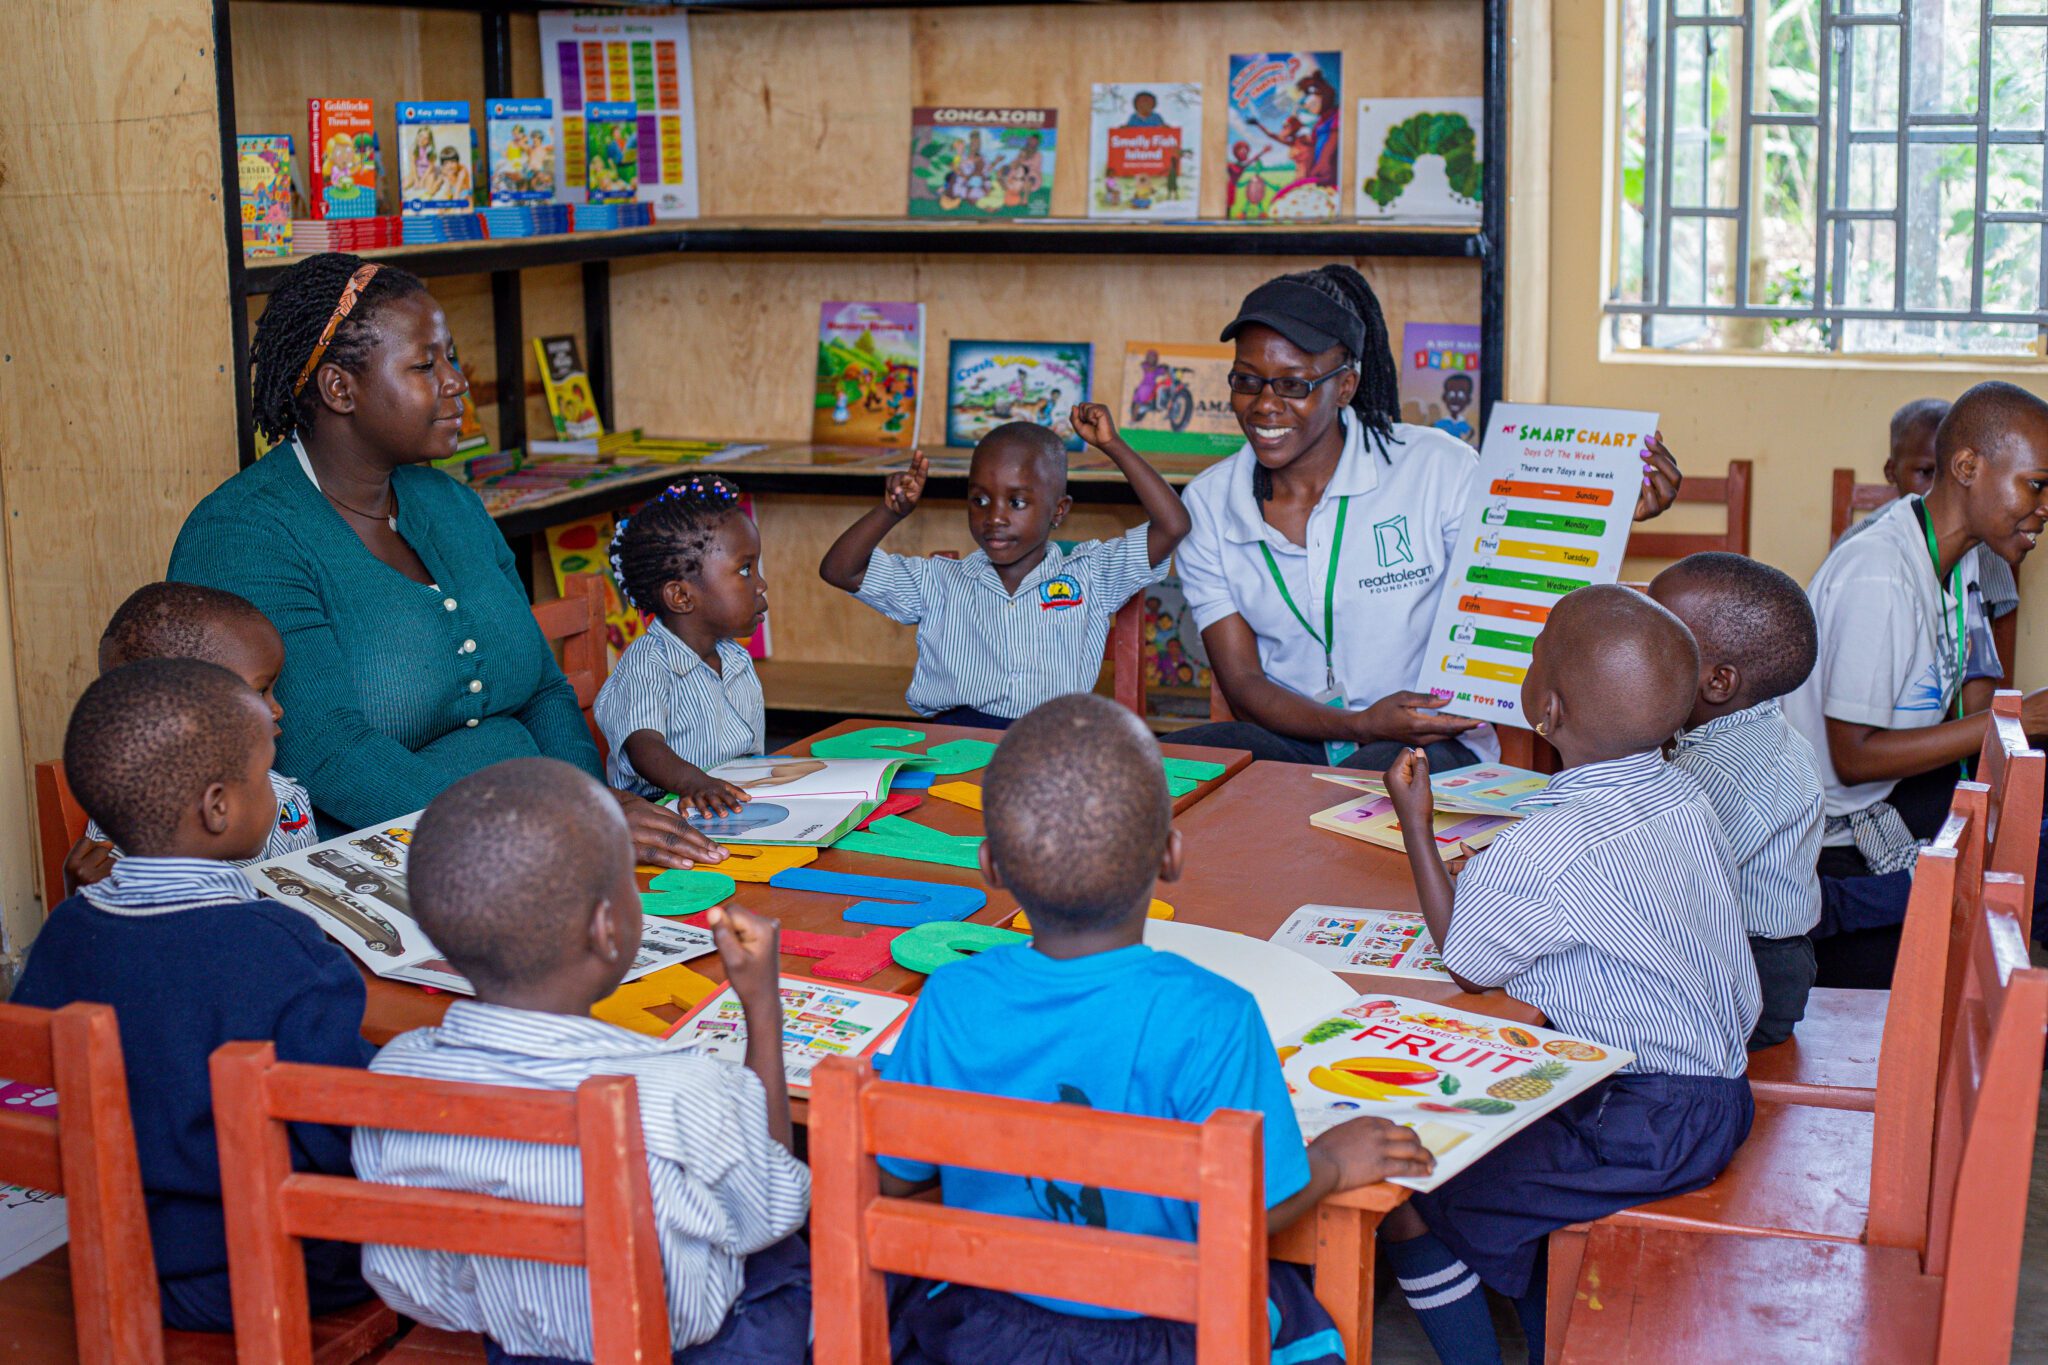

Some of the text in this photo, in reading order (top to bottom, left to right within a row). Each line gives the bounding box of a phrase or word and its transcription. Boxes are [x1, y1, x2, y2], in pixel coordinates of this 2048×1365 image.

[417, 108, 432, 117] Key
[1111, 135, 1178, 150] Smelly Fish
[1124, 148, 1163, 160] Island
[1502, 424, 1637, 447] MY SMART CHART
[1523, 447, 1595, 461] Days Of The Week
[1520, 464, 1539, 473] There
[1595, 472, 1614, 480] week
[1496, 484, 1599, 502] First Sunday
[1488, 512, 1590, 531] Second Monday
[1481, 540, 1591, 564] Third Tuesday
[1358, 564, 1434, 588] readtolearn
[1370, 578, 1429, 594] FOUNDATION
[1546, 580, 1583, 592] Wednesd
[1464, 602, 1481, 611] Fifth
[1457, 633, 1471, 641] Sixth
[1446, 662, 1465, 671] Seventh
[1457, 692, 1471, 702] ARE
[1473, 694, 1494, 705] TOYS
[1497, 699, 1514, 709] TOO
[1380, 1018, 1405, 1026] MY
[1407, 1025, 1464, 1040] JUMBO
[1467, 1038, 1516, 1051] BOOK
[1351, 1025, 1535, 1074] FRUIT
